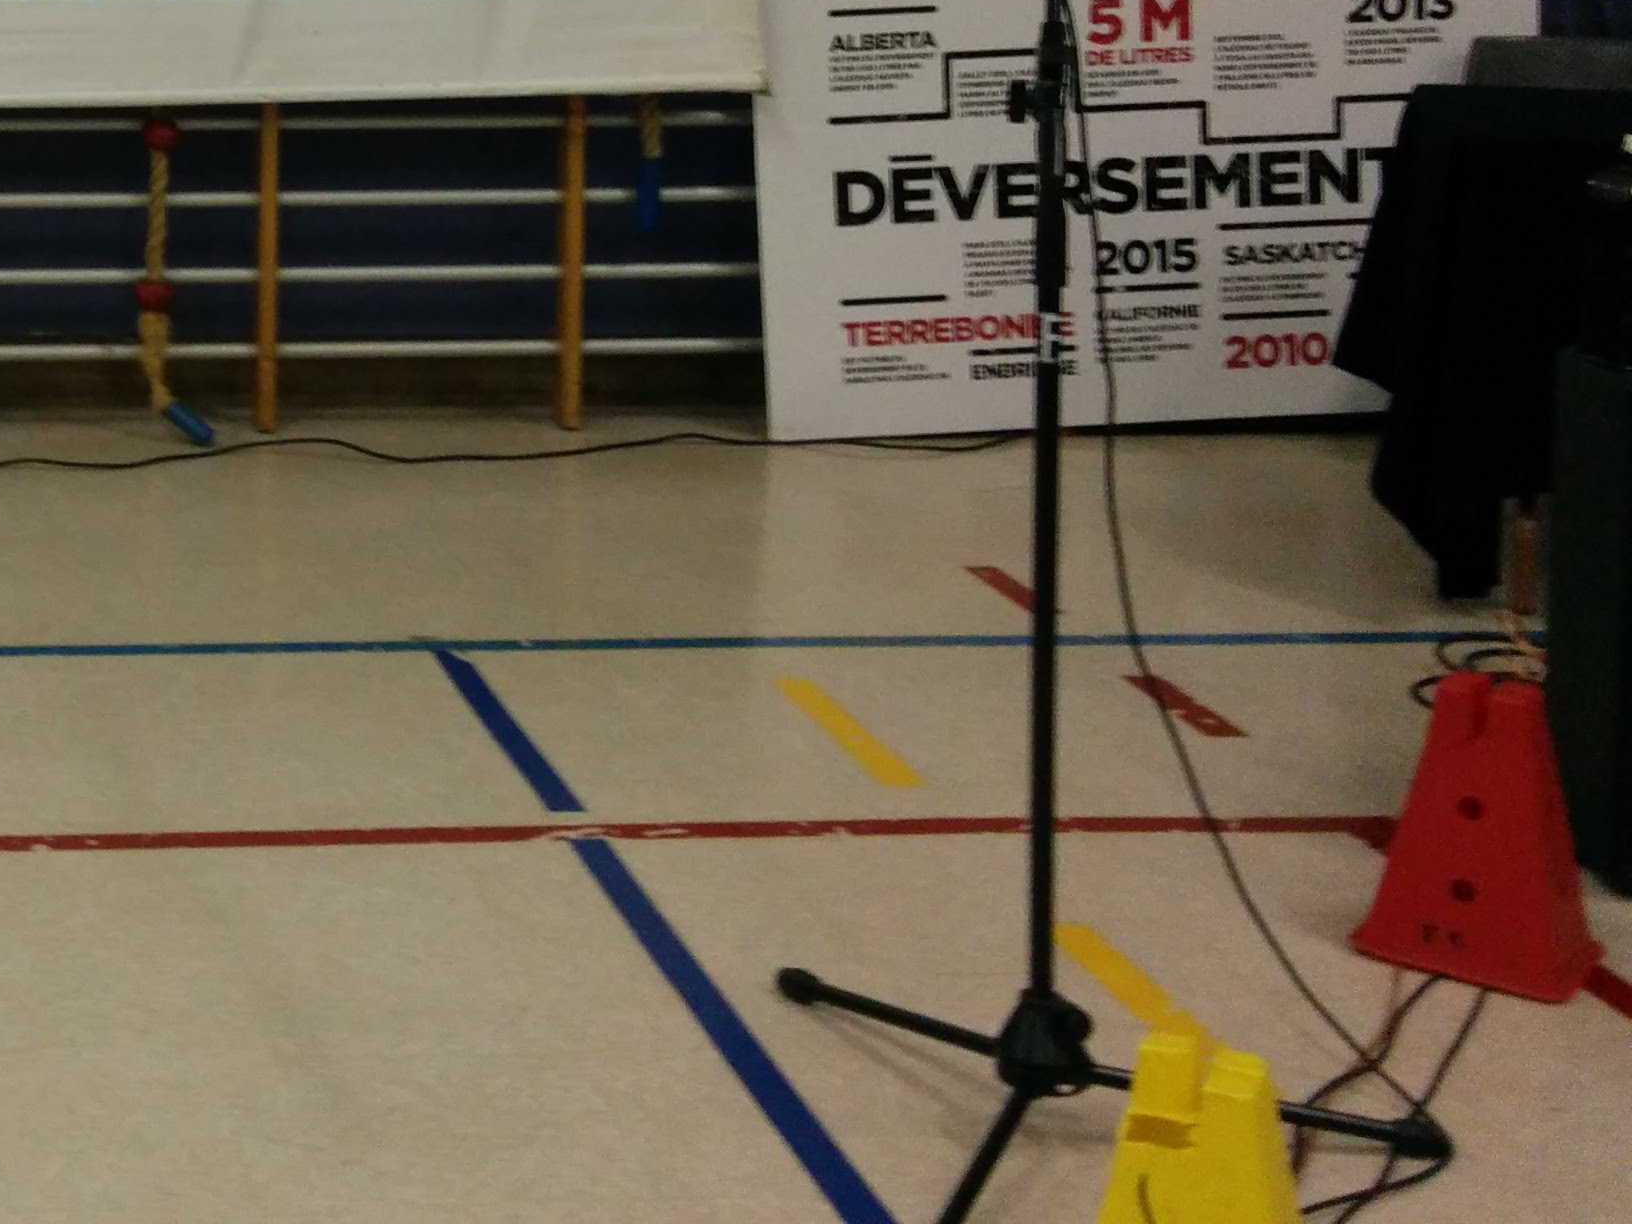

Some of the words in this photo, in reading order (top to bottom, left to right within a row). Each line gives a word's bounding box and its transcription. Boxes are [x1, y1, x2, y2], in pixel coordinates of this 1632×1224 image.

[828, 30, 938, 52] ALBERTA
[1085, 49, 1114, 66] DE
[1119, 46, 1196, 65] LITRES
[1096, 238, 1198, 275] 2015
[1224, 331, 1330, 369] 2010
